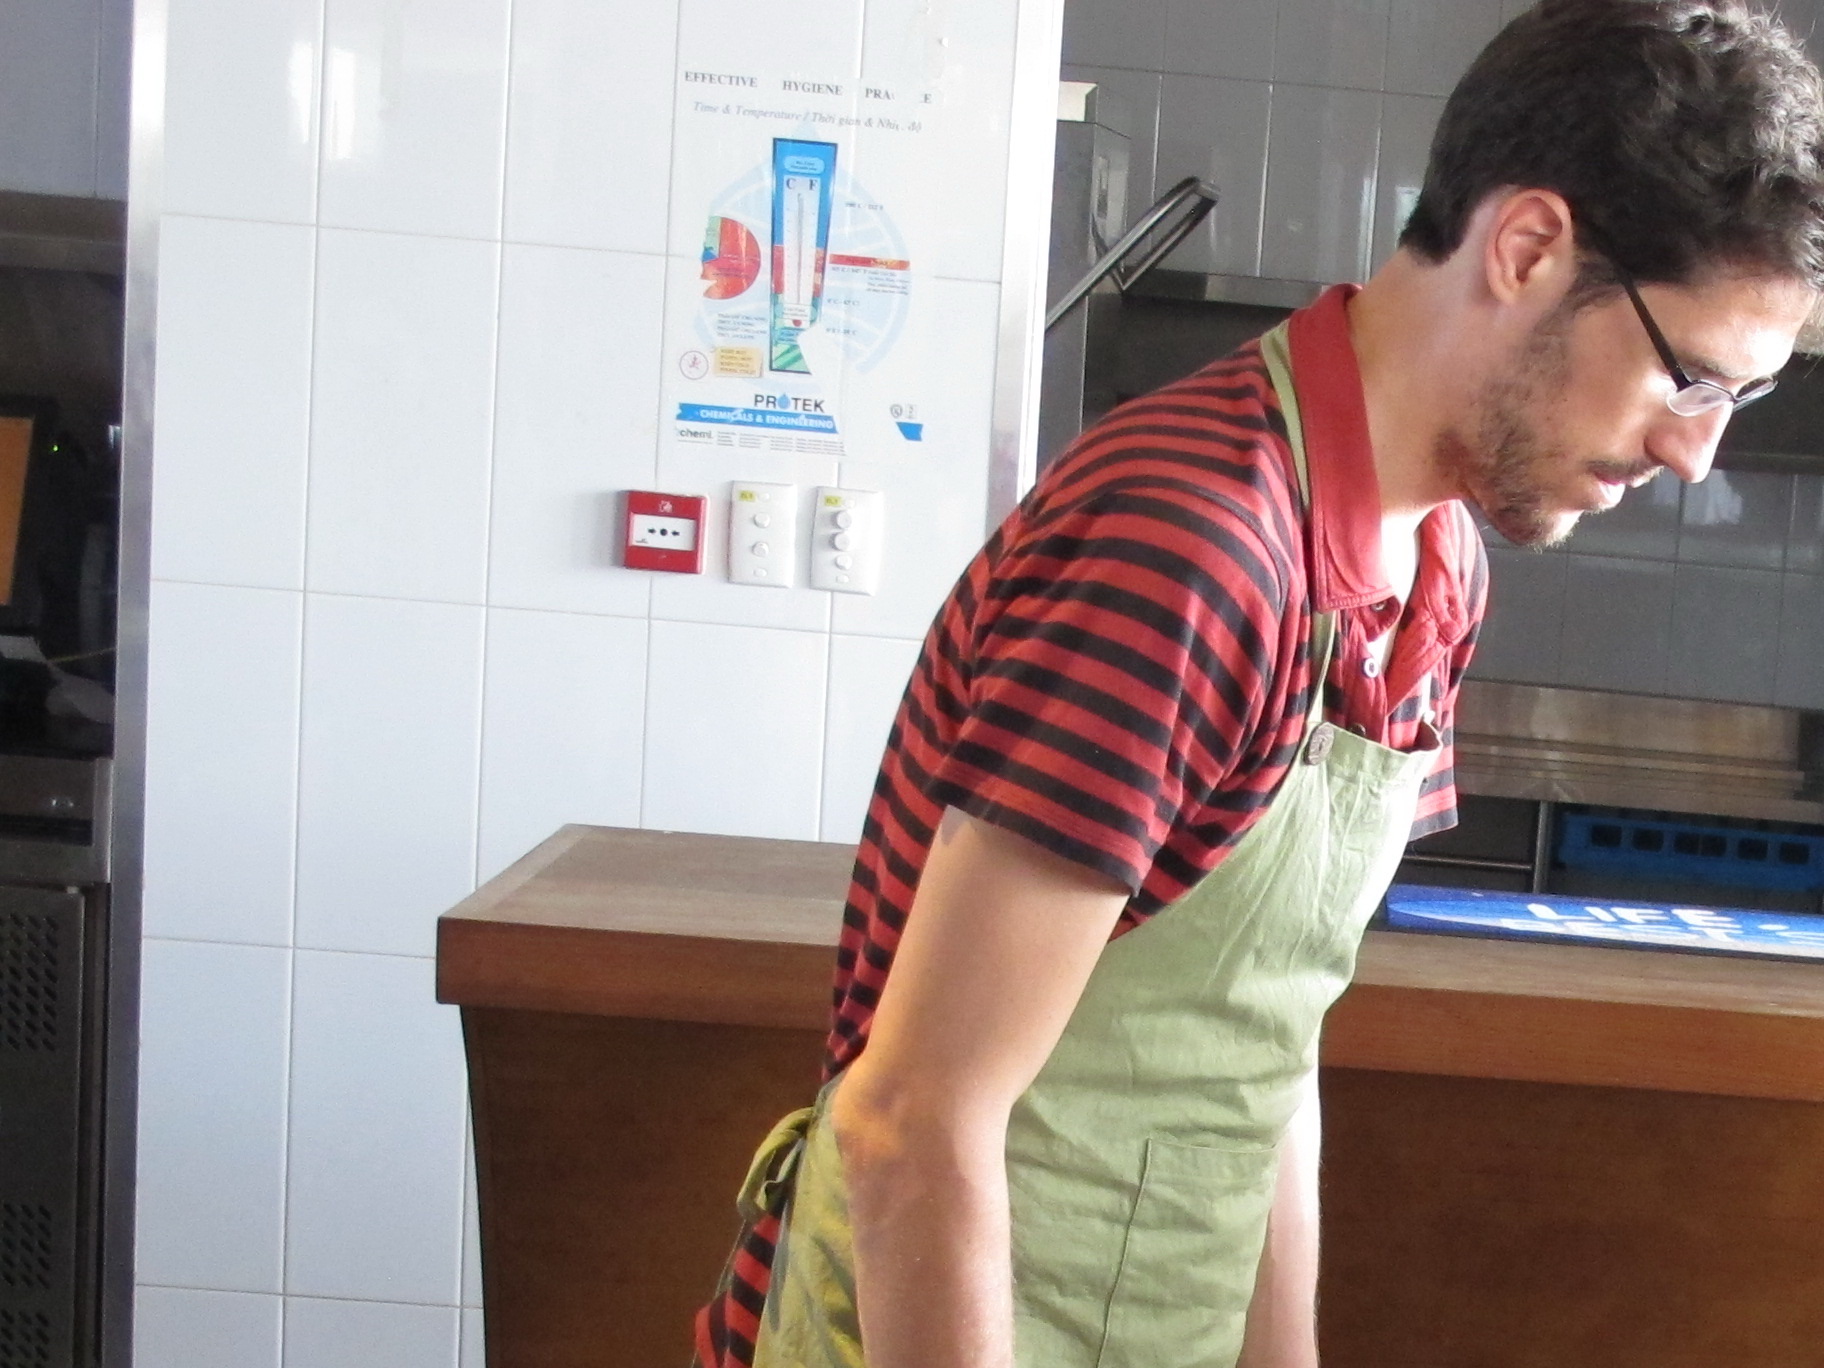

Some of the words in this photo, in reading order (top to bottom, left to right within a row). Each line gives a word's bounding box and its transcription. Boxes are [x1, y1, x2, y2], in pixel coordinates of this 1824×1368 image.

[685, 71, 758, 88] EFFECTIVE
[782, 80, 843, 96] HYGIENE
[722, 104, 731, 115] &
[735, 105, 802, 119] Temperature
[786, 178, 797, 190] C
[808, 179, 818, 190] F
[700, 409, 753, 423] CHEMICALS
[755, 414, 764, 423] &
[766, 415, 834, 429] ENGINEERING
